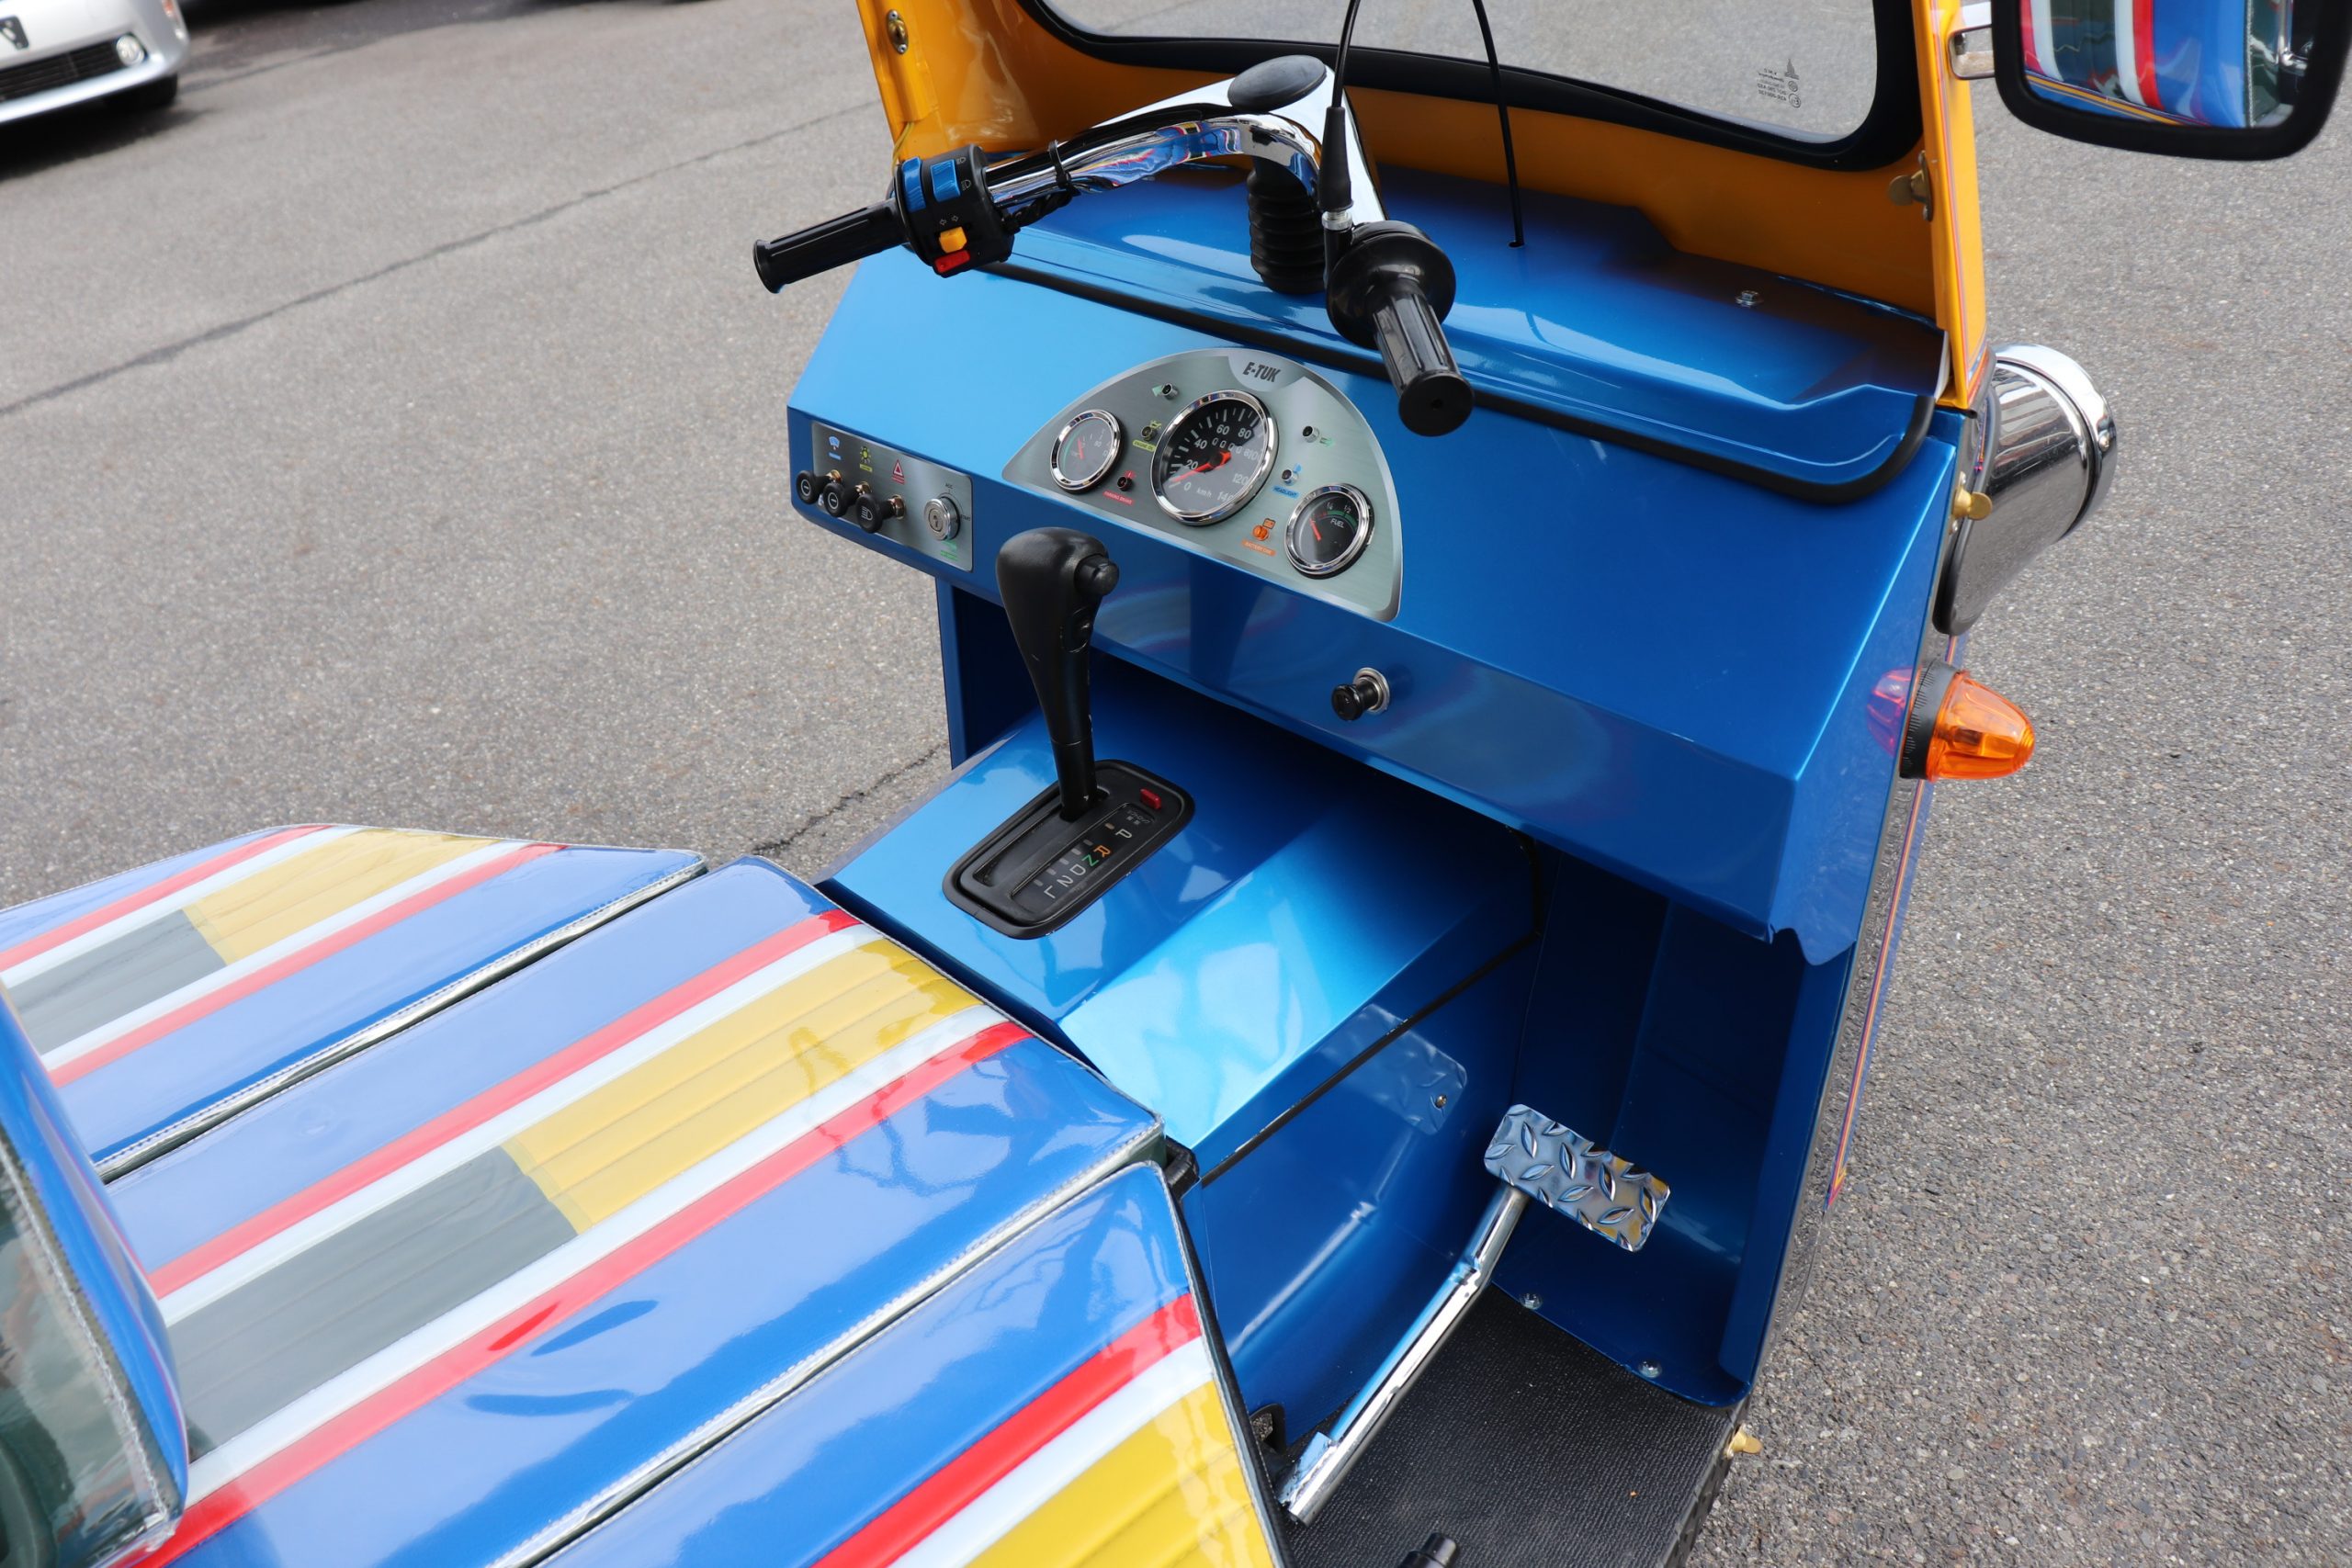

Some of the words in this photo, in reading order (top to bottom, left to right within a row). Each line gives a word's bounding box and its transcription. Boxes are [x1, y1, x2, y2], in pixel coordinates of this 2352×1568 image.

[1243, 361, 1281, 382] E-TUK
[1216, 424, 1229, 434] 60
[1238, 428, 1251, 439] 80
[1194, 439, 1207, 449] 40
[1187, 459, 1198, 469] 20
[1233, 473, 1250, 485] 120
[1184, 482, 1191, 491] 0
[1330, 517, 1344, 528] FUEL
[1114, 829, 1132, 839] P
[1093, 845, 1112, 858] R
[1081, 854, 1099, 866] N
[1069, 863, 1086, 875] D
[1057, 874, 1074, 887] 2
[1044, 885, 1056, 898] L
